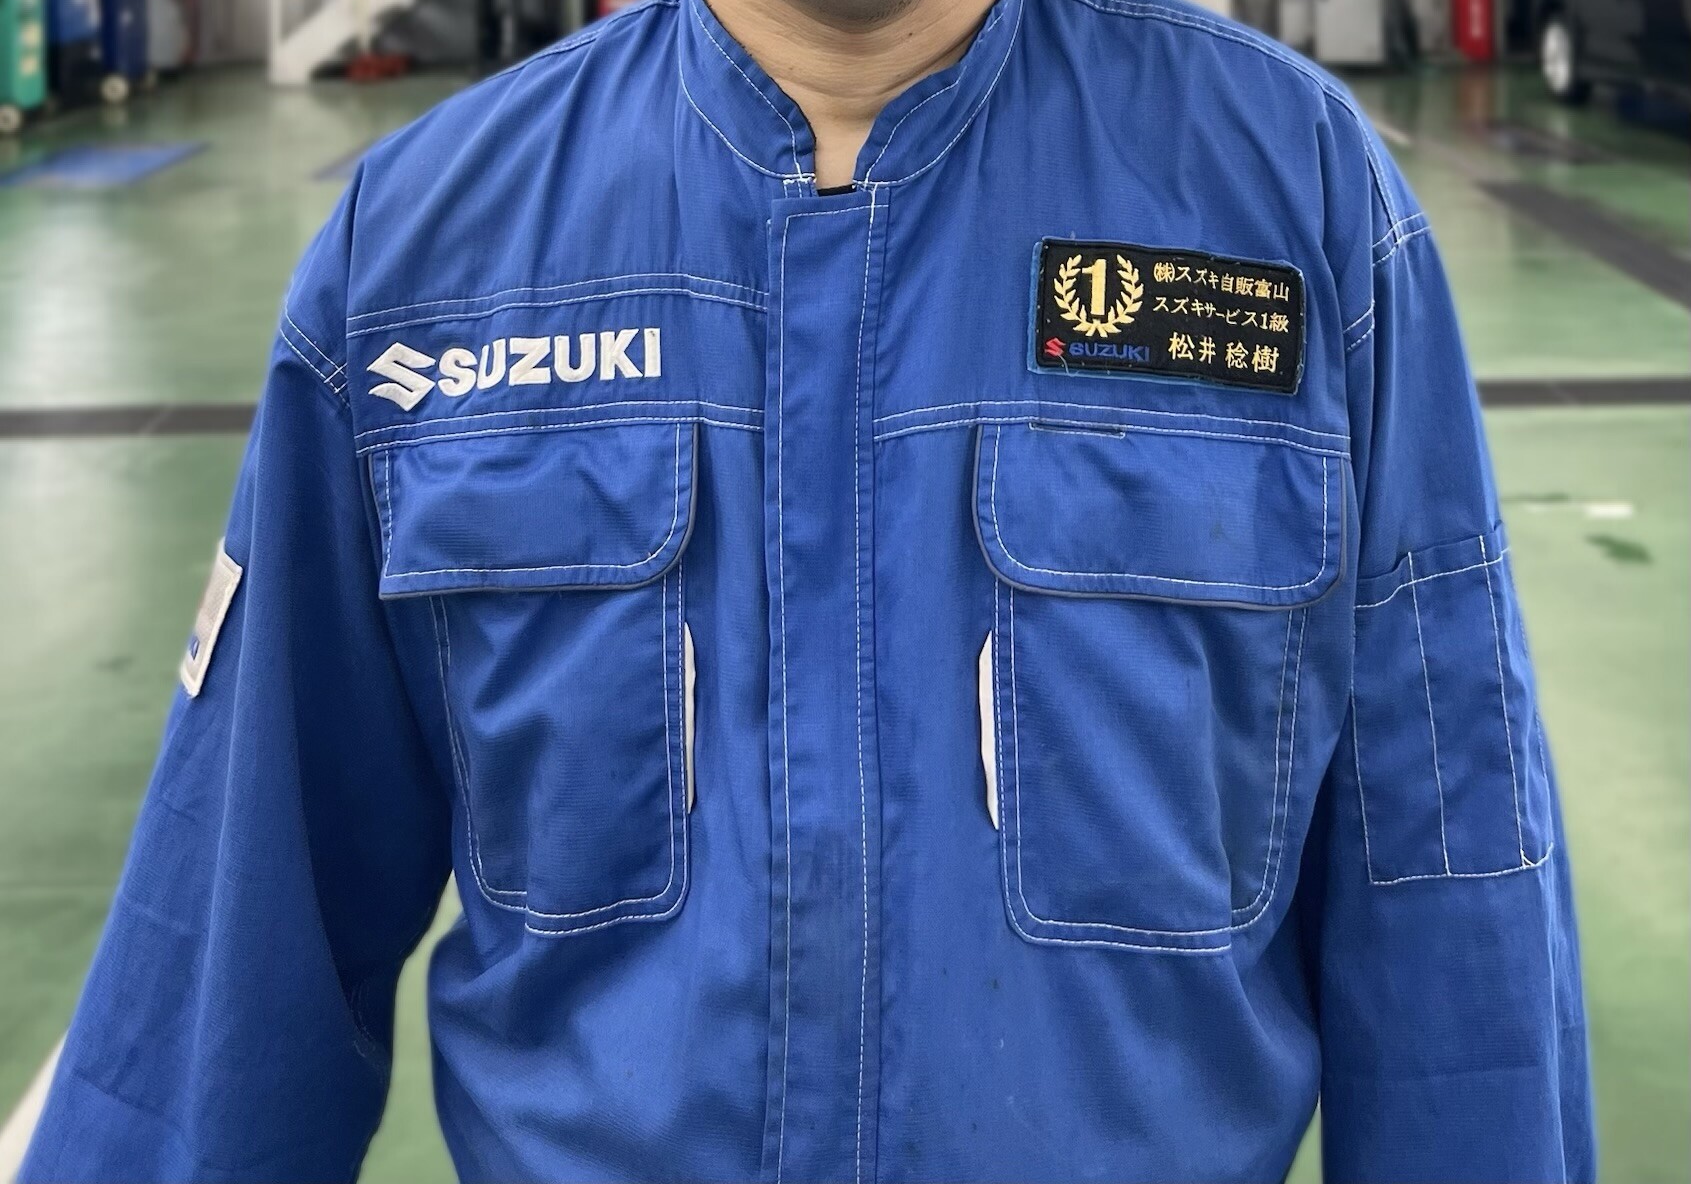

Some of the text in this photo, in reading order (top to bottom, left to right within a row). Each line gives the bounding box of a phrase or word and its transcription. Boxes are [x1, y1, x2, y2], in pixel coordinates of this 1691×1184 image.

[1081, 258, 1107, 316] 1
[437, 327, 662, 397] SUZUKI
[1069, 341, 1150, 362] SUZUKI
